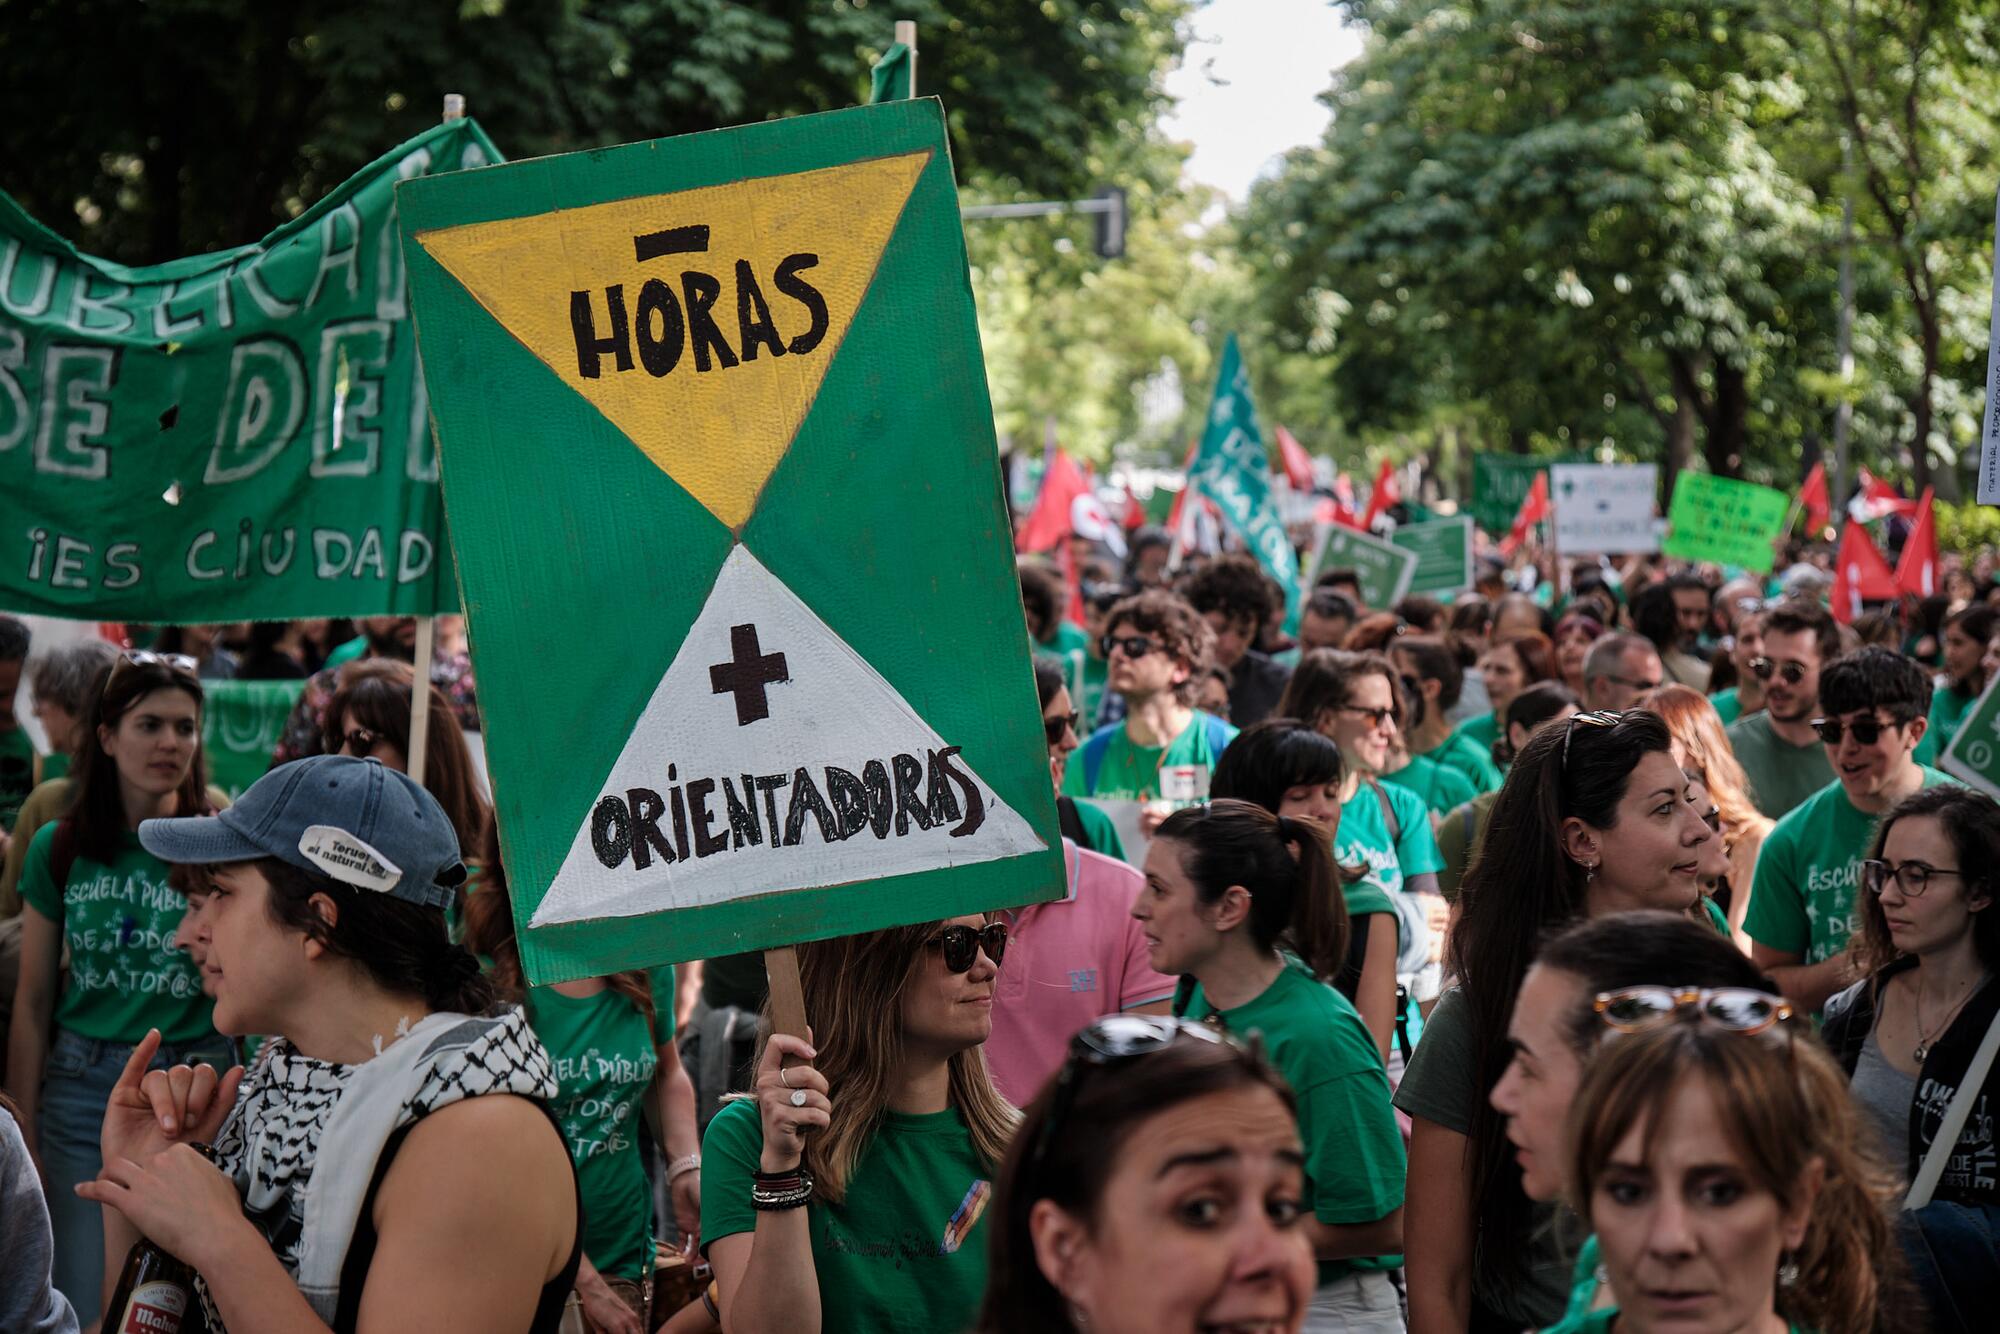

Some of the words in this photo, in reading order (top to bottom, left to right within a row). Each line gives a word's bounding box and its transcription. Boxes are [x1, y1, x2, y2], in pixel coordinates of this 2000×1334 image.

[570, 253, 829, 378] HORAS
[1808, 858, 1865, 892] ESCU
[71, 928, 98, 951] DE
[110, 928, 191, 957] TOD@
[136, 1307, 179, 1334] Maho
